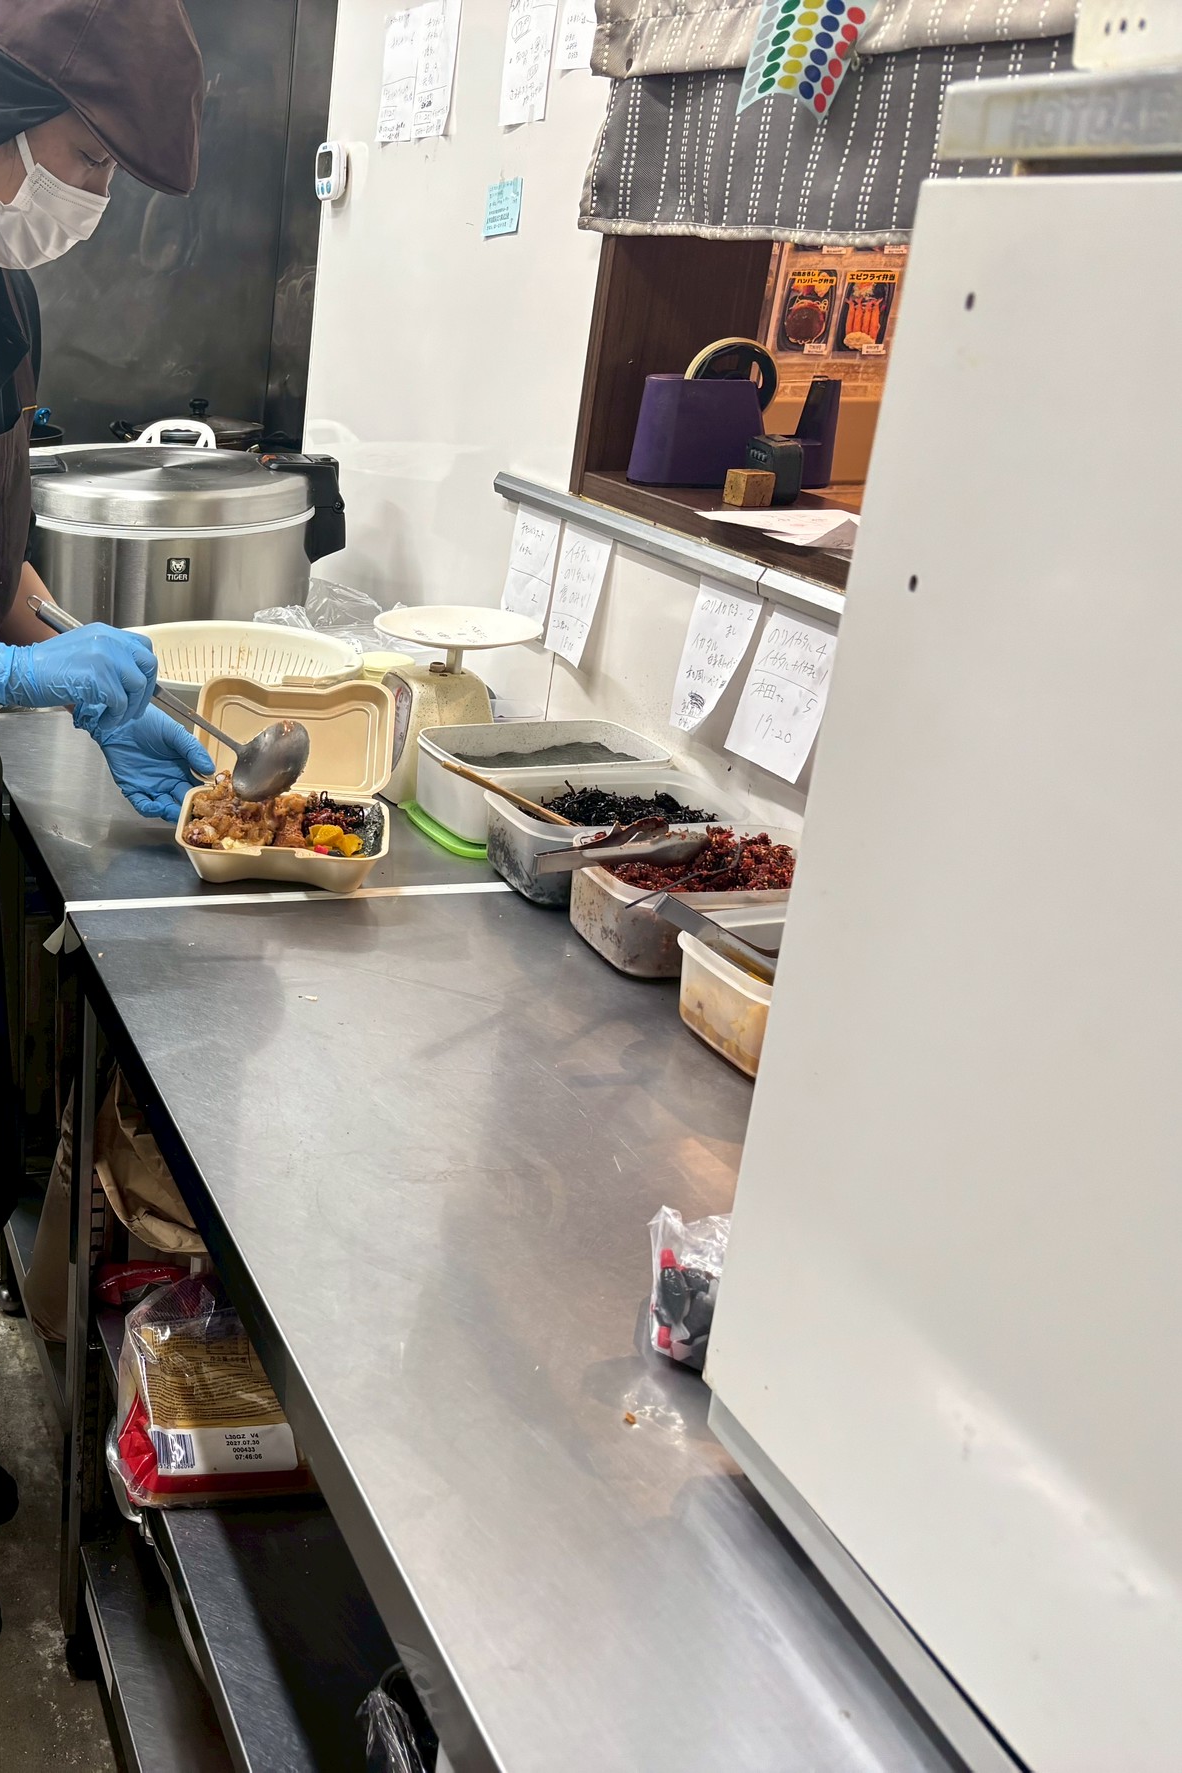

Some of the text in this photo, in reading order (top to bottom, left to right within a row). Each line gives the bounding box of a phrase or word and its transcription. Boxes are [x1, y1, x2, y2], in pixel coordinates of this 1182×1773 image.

[849, 273, 896, 281] エビフライ弁当
[167, 573, 188, 581] TIGER
[815, 643, 827, 661] 4
[802, 698, 818, 713] 5
